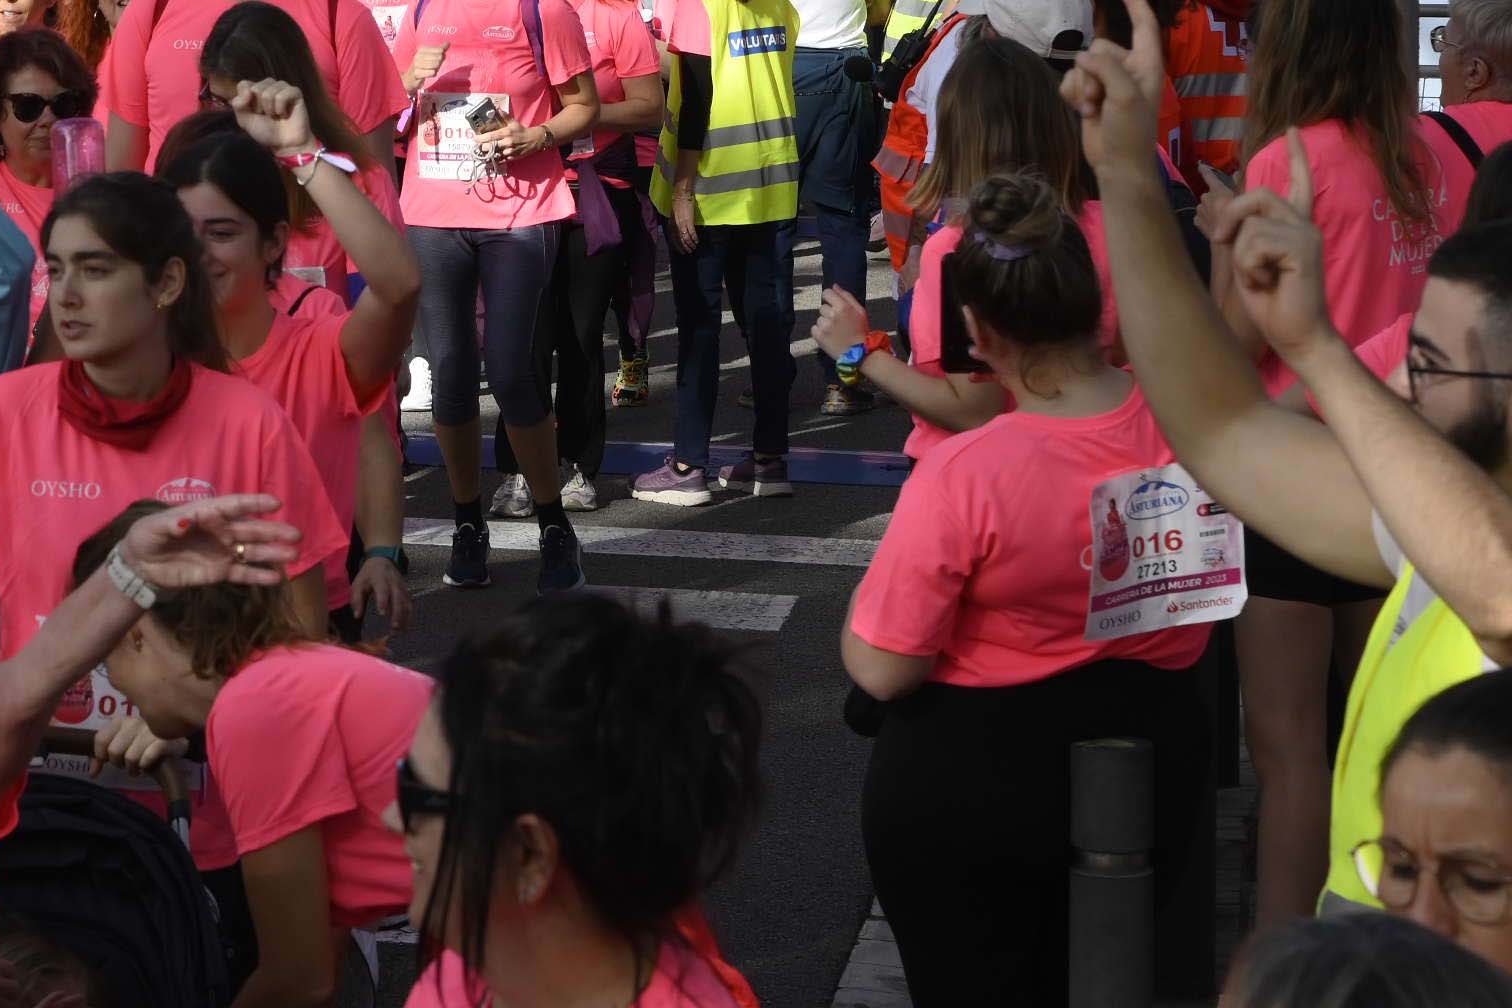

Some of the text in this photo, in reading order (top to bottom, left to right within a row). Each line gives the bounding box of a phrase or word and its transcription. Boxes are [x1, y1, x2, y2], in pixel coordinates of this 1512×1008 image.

[31, 479, 101, 499] OYSHO
[1129, 494, 1184, 515] ASTURIANA
[1132, 529, 1184, 559] 016
[1137, 559, 1178, 580] 27213
[1141, 586, 1153, 596] DE
[1154, 583, 1167, 593] LA
[1168, 578, 1203, 592] MUJER
[1099, 595, 1235, 631] OYSHO Santander
[98, 695, 134, 717] 01
